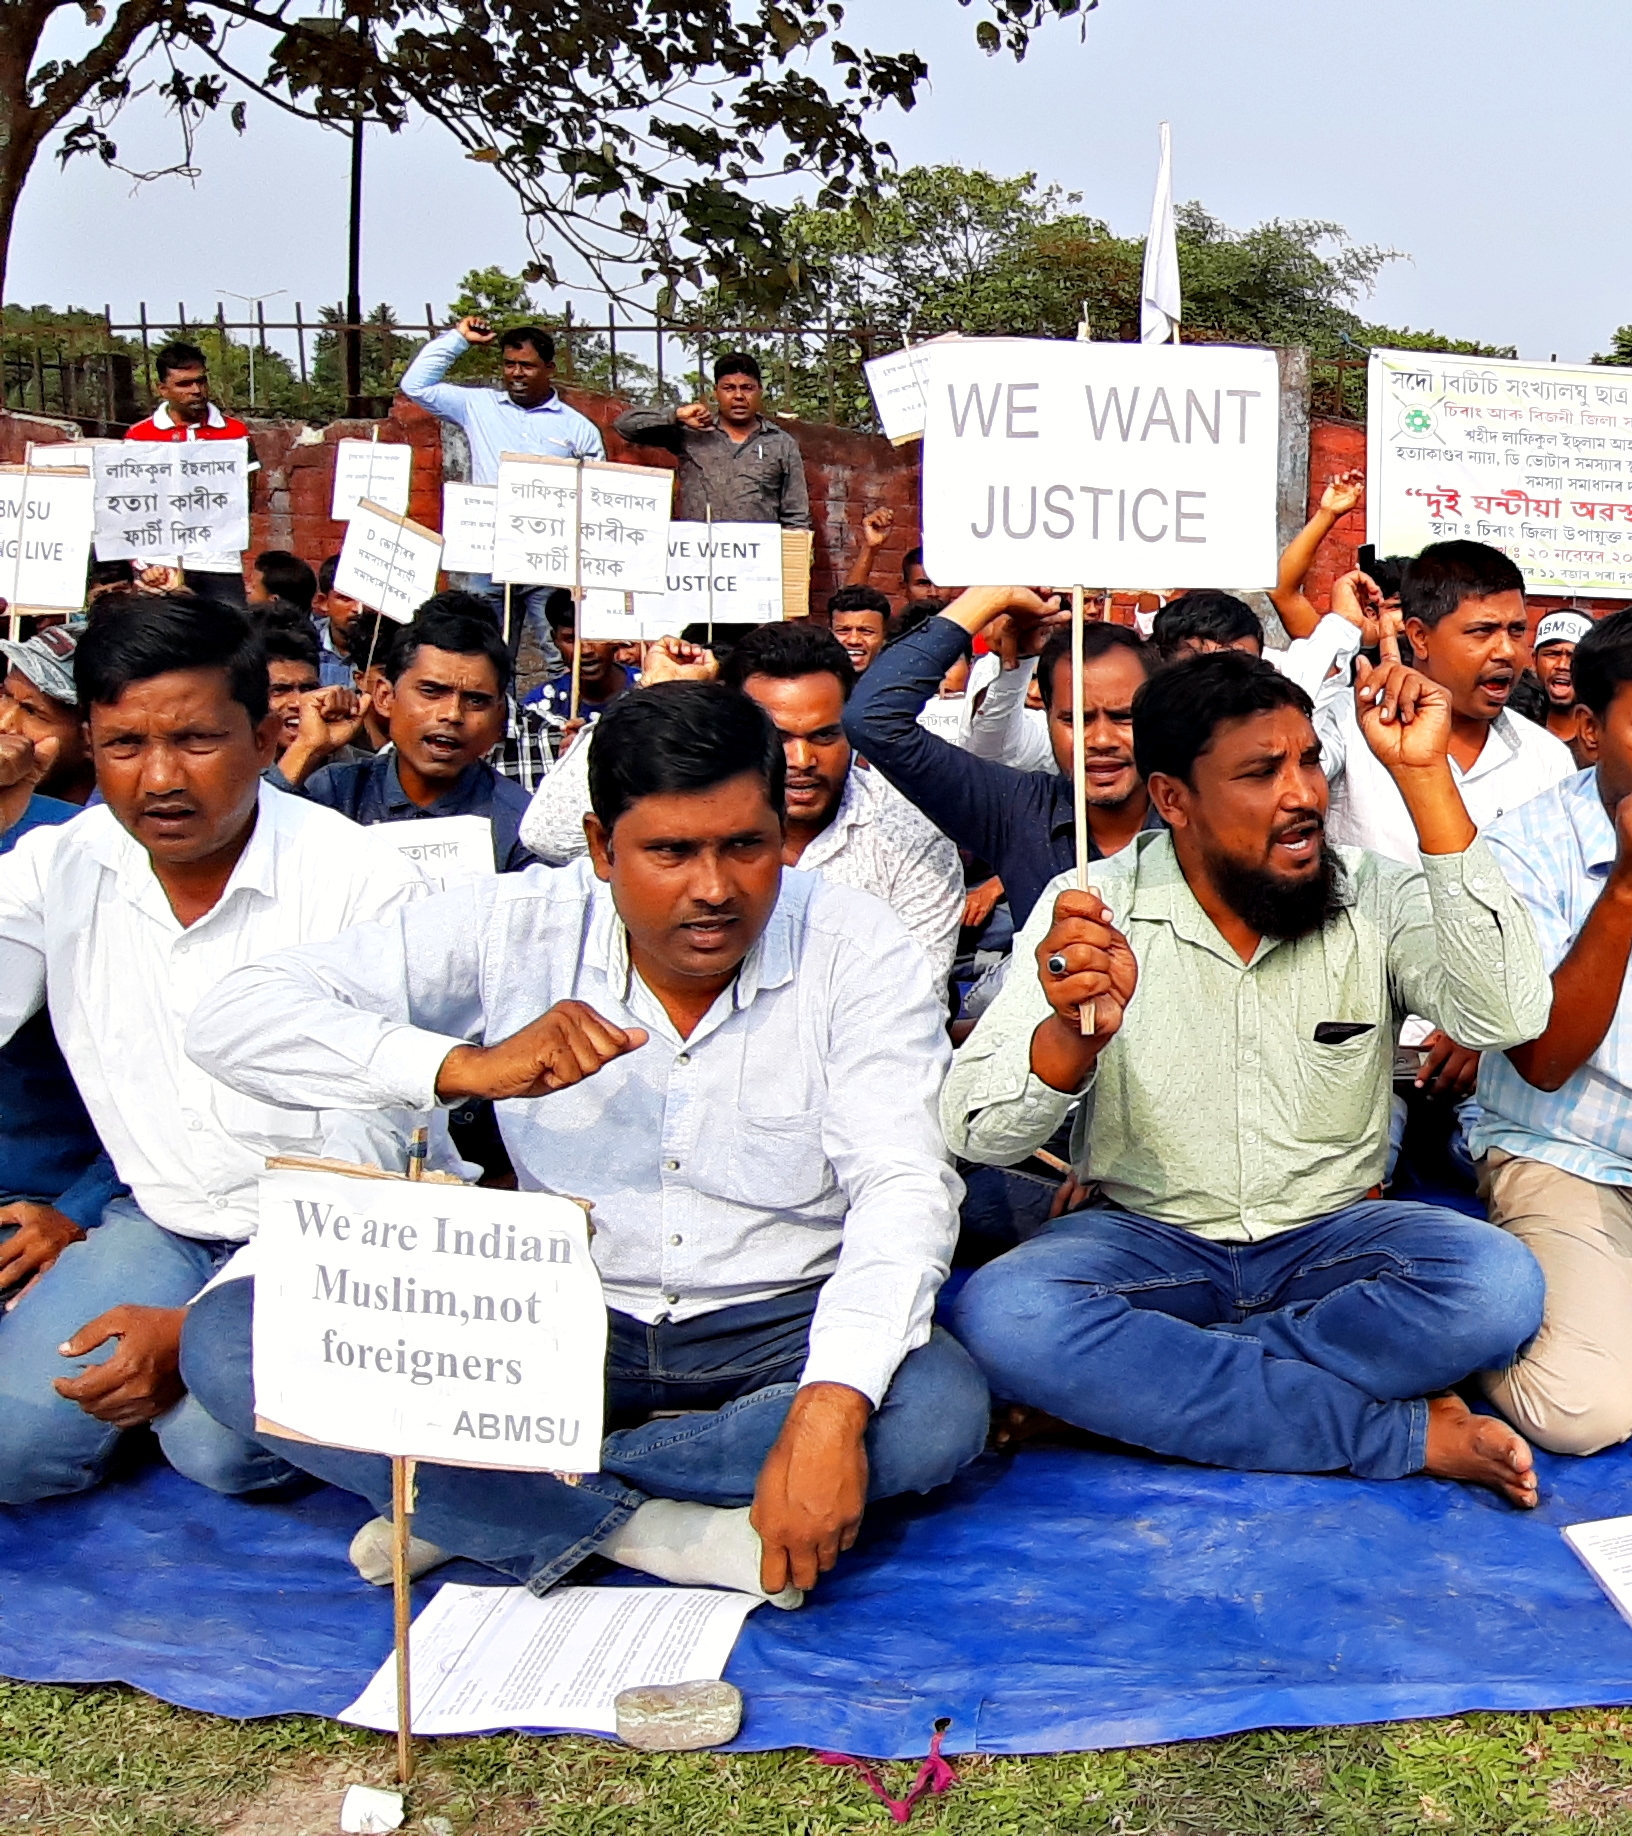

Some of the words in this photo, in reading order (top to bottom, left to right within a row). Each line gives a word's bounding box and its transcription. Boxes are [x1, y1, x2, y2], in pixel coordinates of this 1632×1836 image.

[947, 382, 1039, 438] WE
[1085, 385, 1261, 444] WANT
[105, 458, 173, 483] লাফিকুল
[106, 494, 158, 514] হত্যা
[590, 487, 658, 511] ইছলামৰ
[970, 484, 1207, 543] JUSTICE
[367, 529, 375, 540] D
[509, 515, 566, 537] হত্যা
[25, 541, 63, 561] LIVE
[700, 542, 760, 559] WENT
[667, 576, 737, 592] USTICE
[293, 1199, 351, 1241] We
[361, 1218, 418, 1252] are
[432, 1216, 573, 1264] Indian
[321, 1329, 522, 1386] foreigners
[453, 1410, 580, 1447] ABMSU
